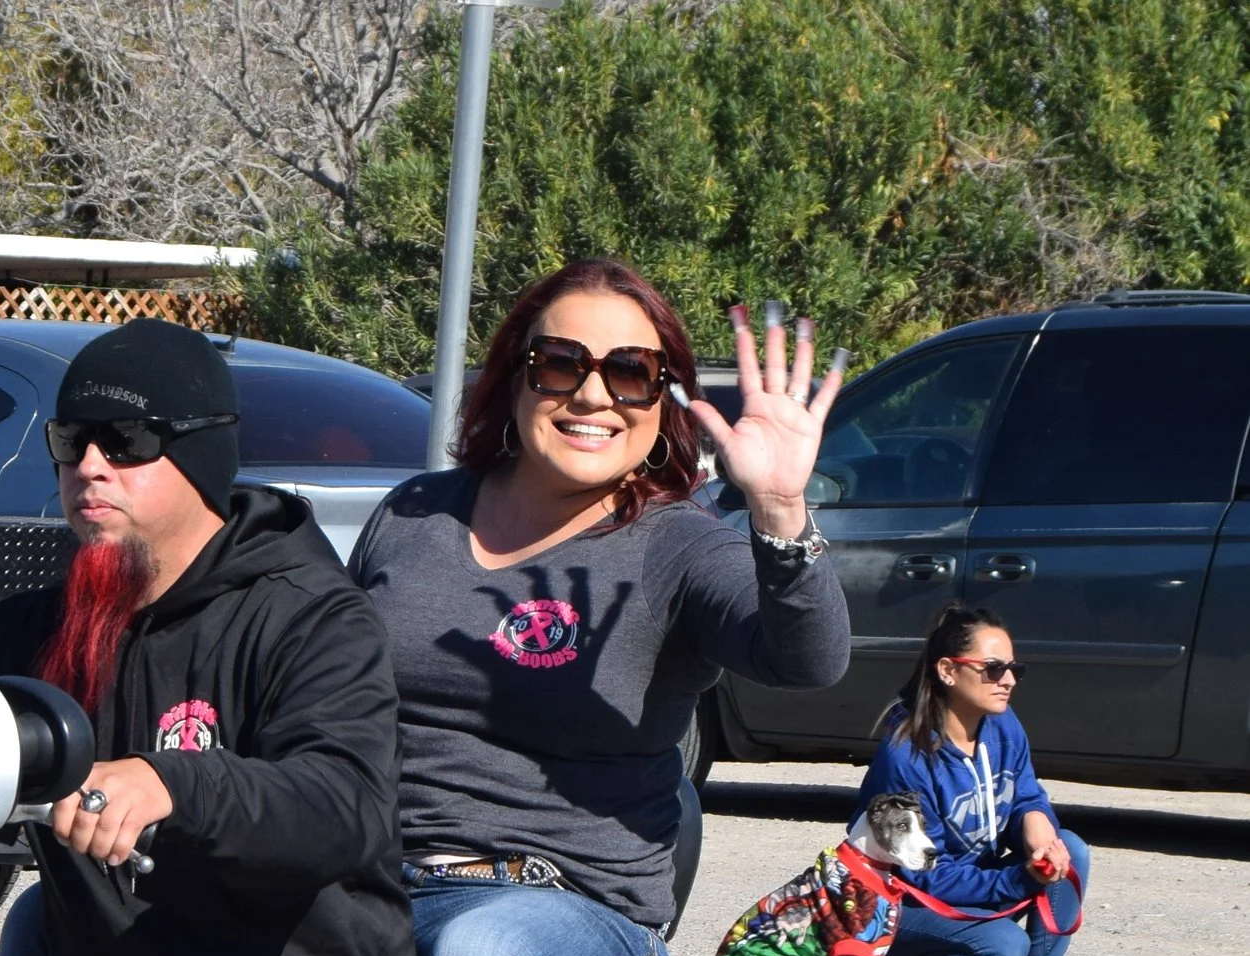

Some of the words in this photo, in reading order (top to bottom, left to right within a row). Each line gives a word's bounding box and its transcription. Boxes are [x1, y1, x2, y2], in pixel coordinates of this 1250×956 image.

[517, 648, 579, 668] BOOBS
[163, 733, 180, 750] 20
[198, 731, 212, 748] 19
